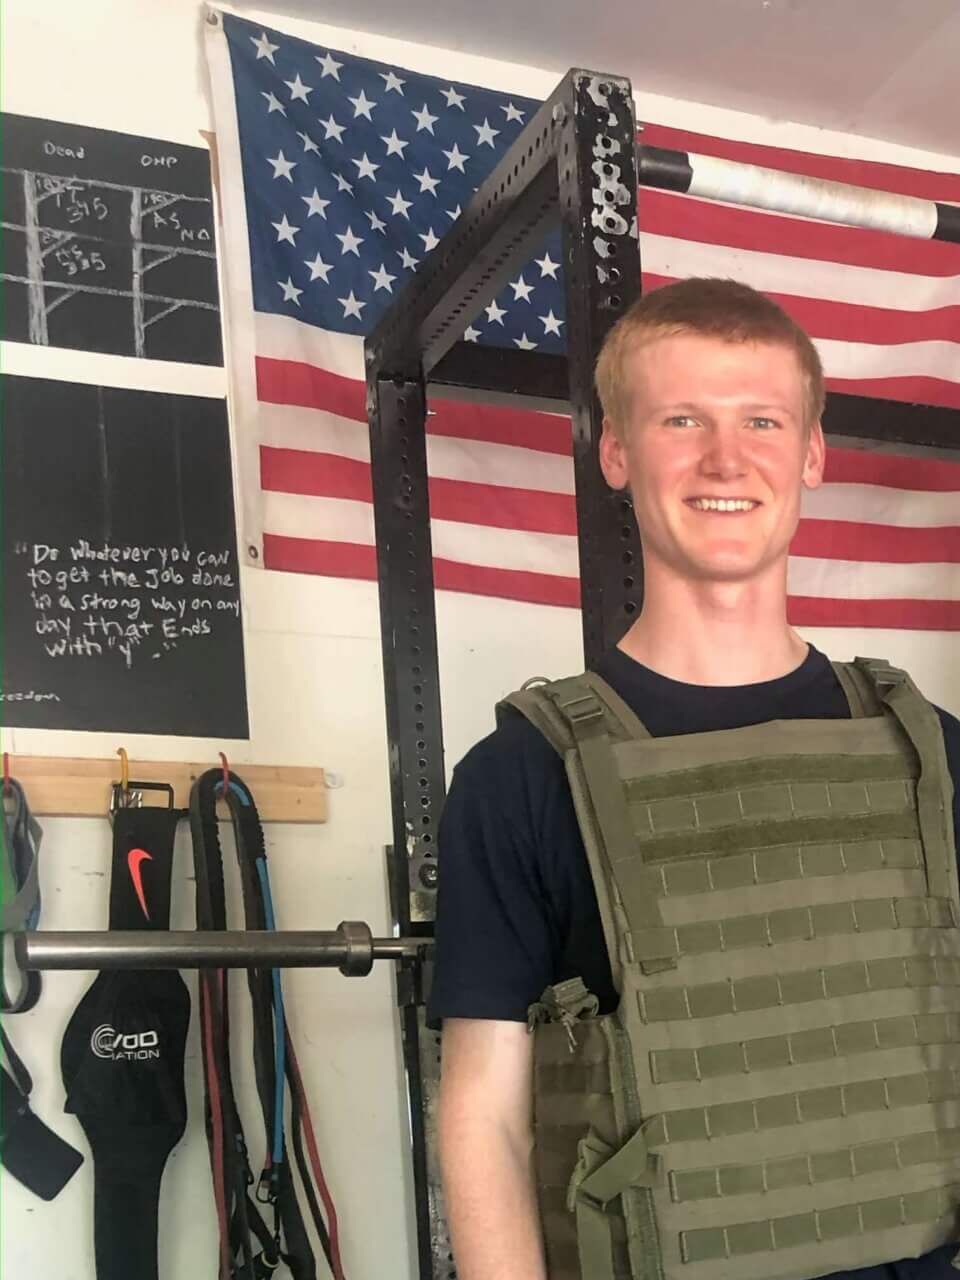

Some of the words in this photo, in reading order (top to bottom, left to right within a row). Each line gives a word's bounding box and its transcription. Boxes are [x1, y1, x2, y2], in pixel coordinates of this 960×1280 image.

[99, 567, 142, 588] the
[191, 565, 235, 588] done
[190, 597, 213, 611] on
[216, 599, 241, 617] any
[83, 614, 154, 639] that
